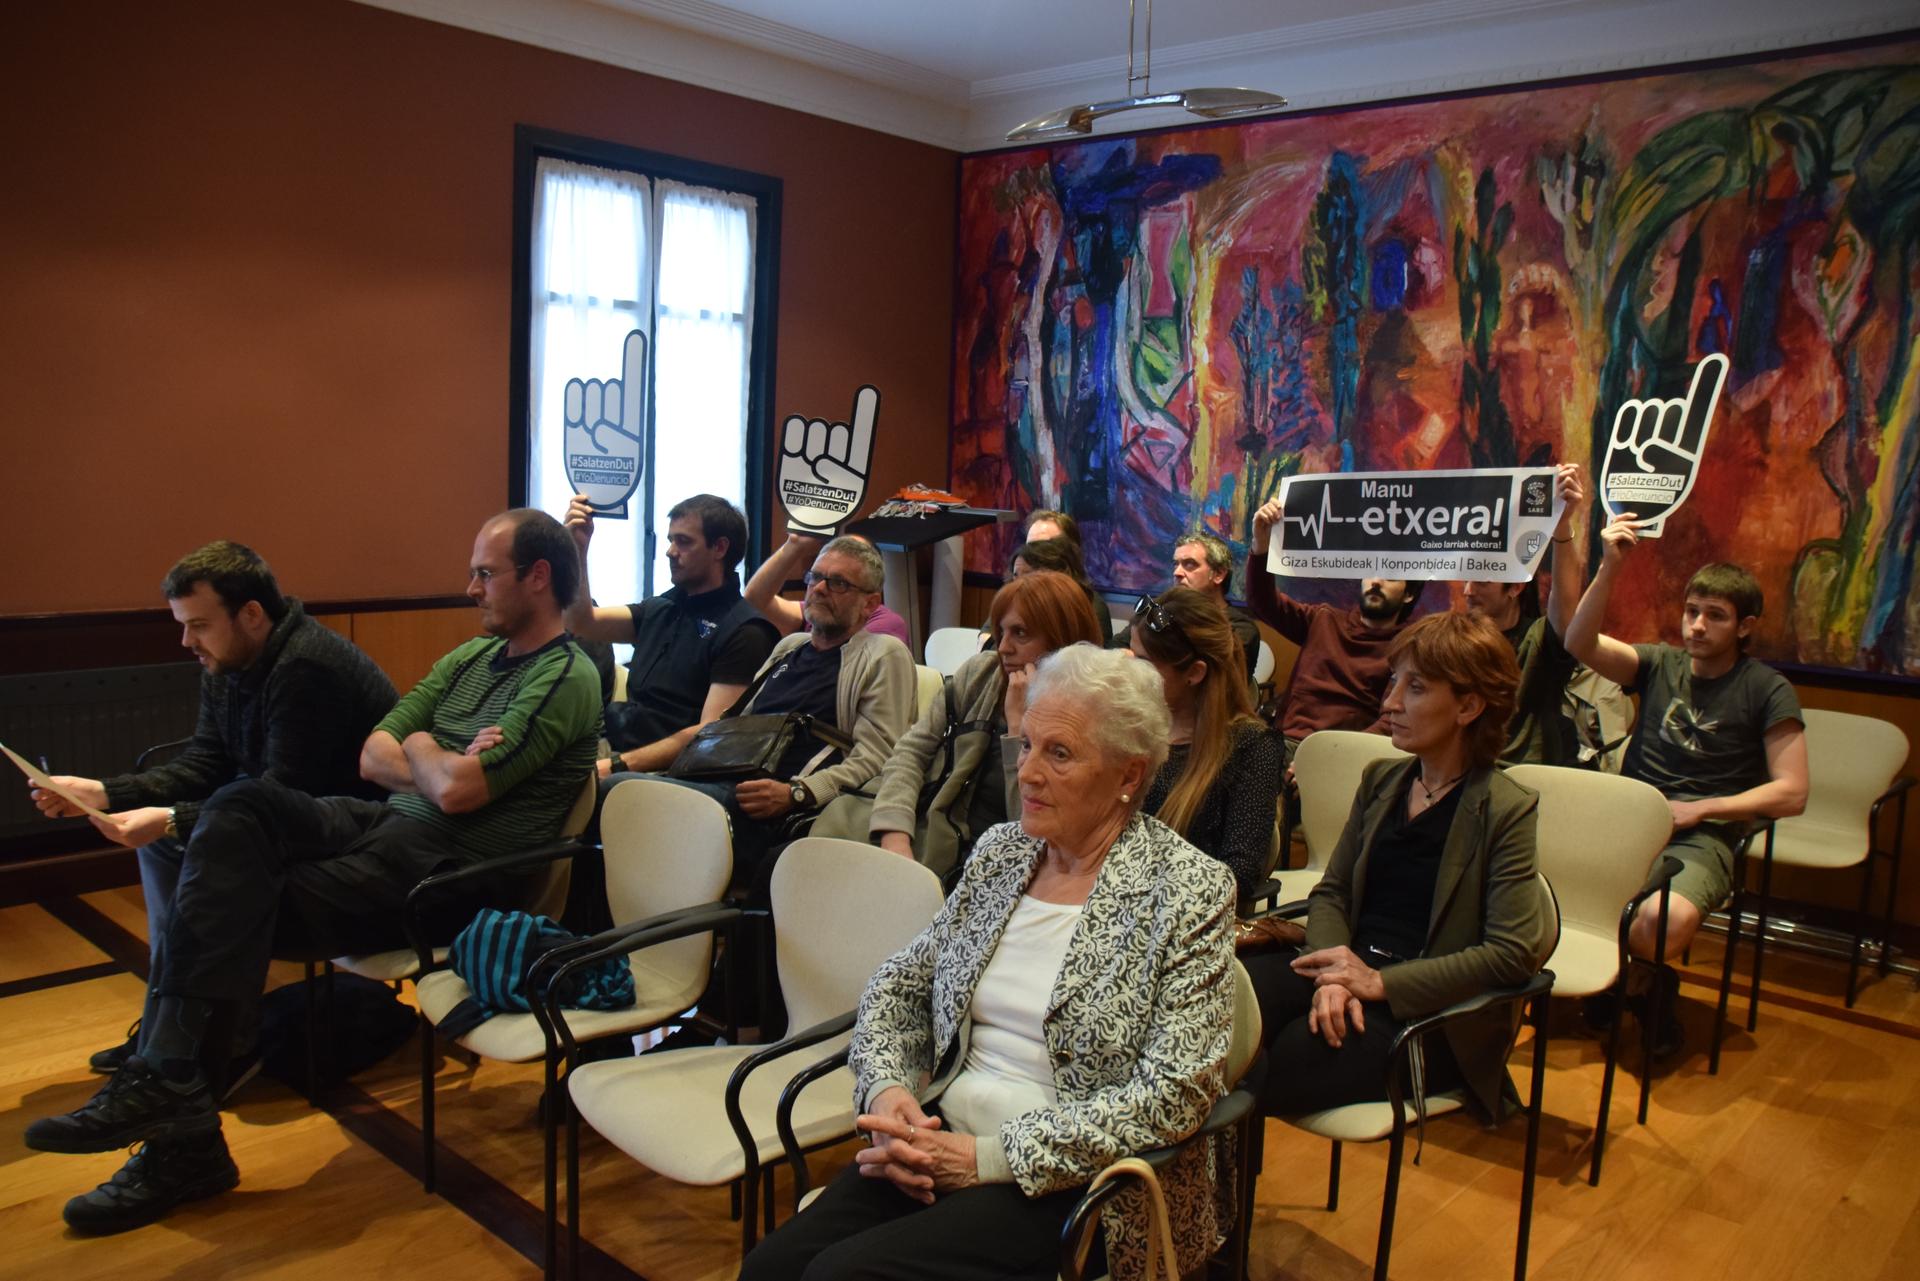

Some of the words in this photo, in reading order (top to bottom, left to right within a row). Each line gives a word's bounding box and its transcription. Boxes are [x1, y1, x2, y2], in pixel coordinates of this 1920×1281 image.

[571, 456, 634, 470] #SalatzenDut
[575, 472, 630, 485] #YoDenuncio
[1609, 475, 1682, 488] #SalatzenDut
[785, 481, 855, 502] #SalatzenDut
[1361, 480, 1413, 498] Manu
[787, 495, 847, 512] #YoDenuncio
[1362, 498, 1504, 538] etxera!
[1420, 540, 1442, 549] Gaixo
[1443, 540, 1469, 549] larriak
[1470, 540, 1502, 549] etxera!
[1281, 556, 1308, 568] Giza
[1311, 557, 1372, 569] Eskubideak
[1381, 558, 1456, 572] Konponbidea
[1467, 558, 1507, 571] Bakea
